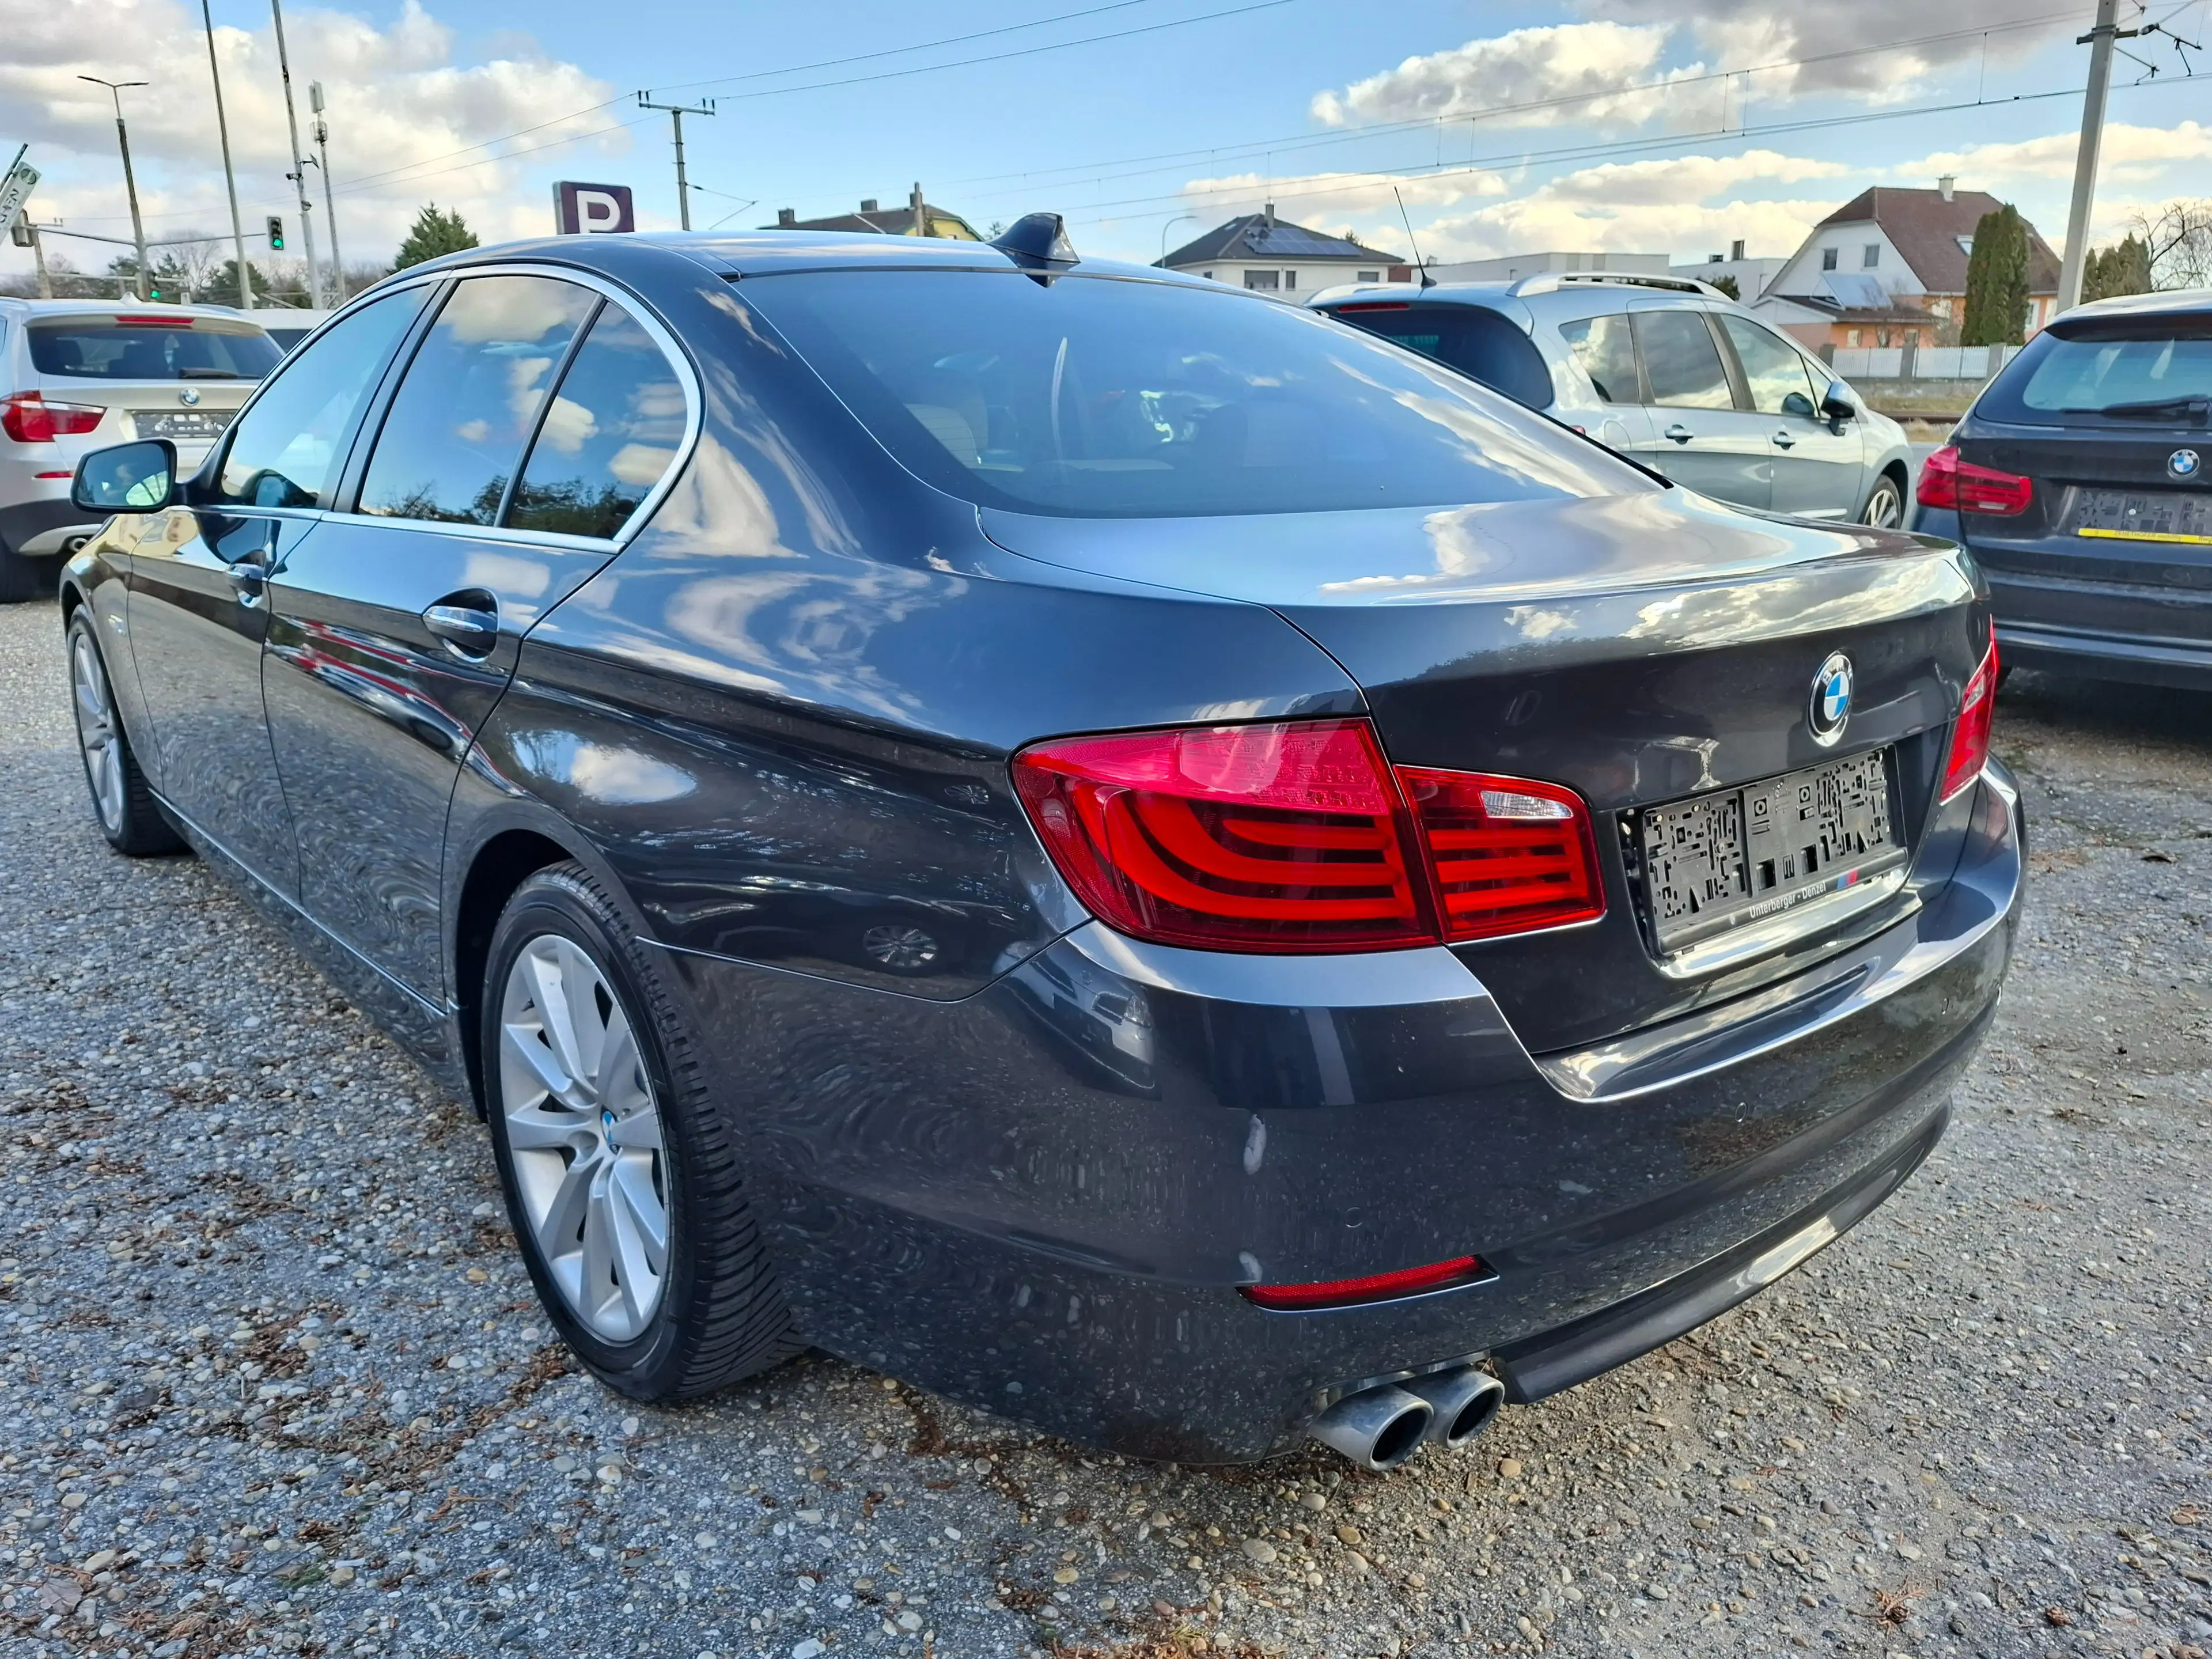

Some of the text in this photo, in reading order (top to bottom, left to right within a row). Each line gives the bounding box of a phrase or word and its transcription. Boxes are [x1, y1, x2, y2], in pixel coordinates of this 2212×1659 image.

[576, 190, 620, 233] P
[1749, 881, 1827, 919] Unterberger Denzel
